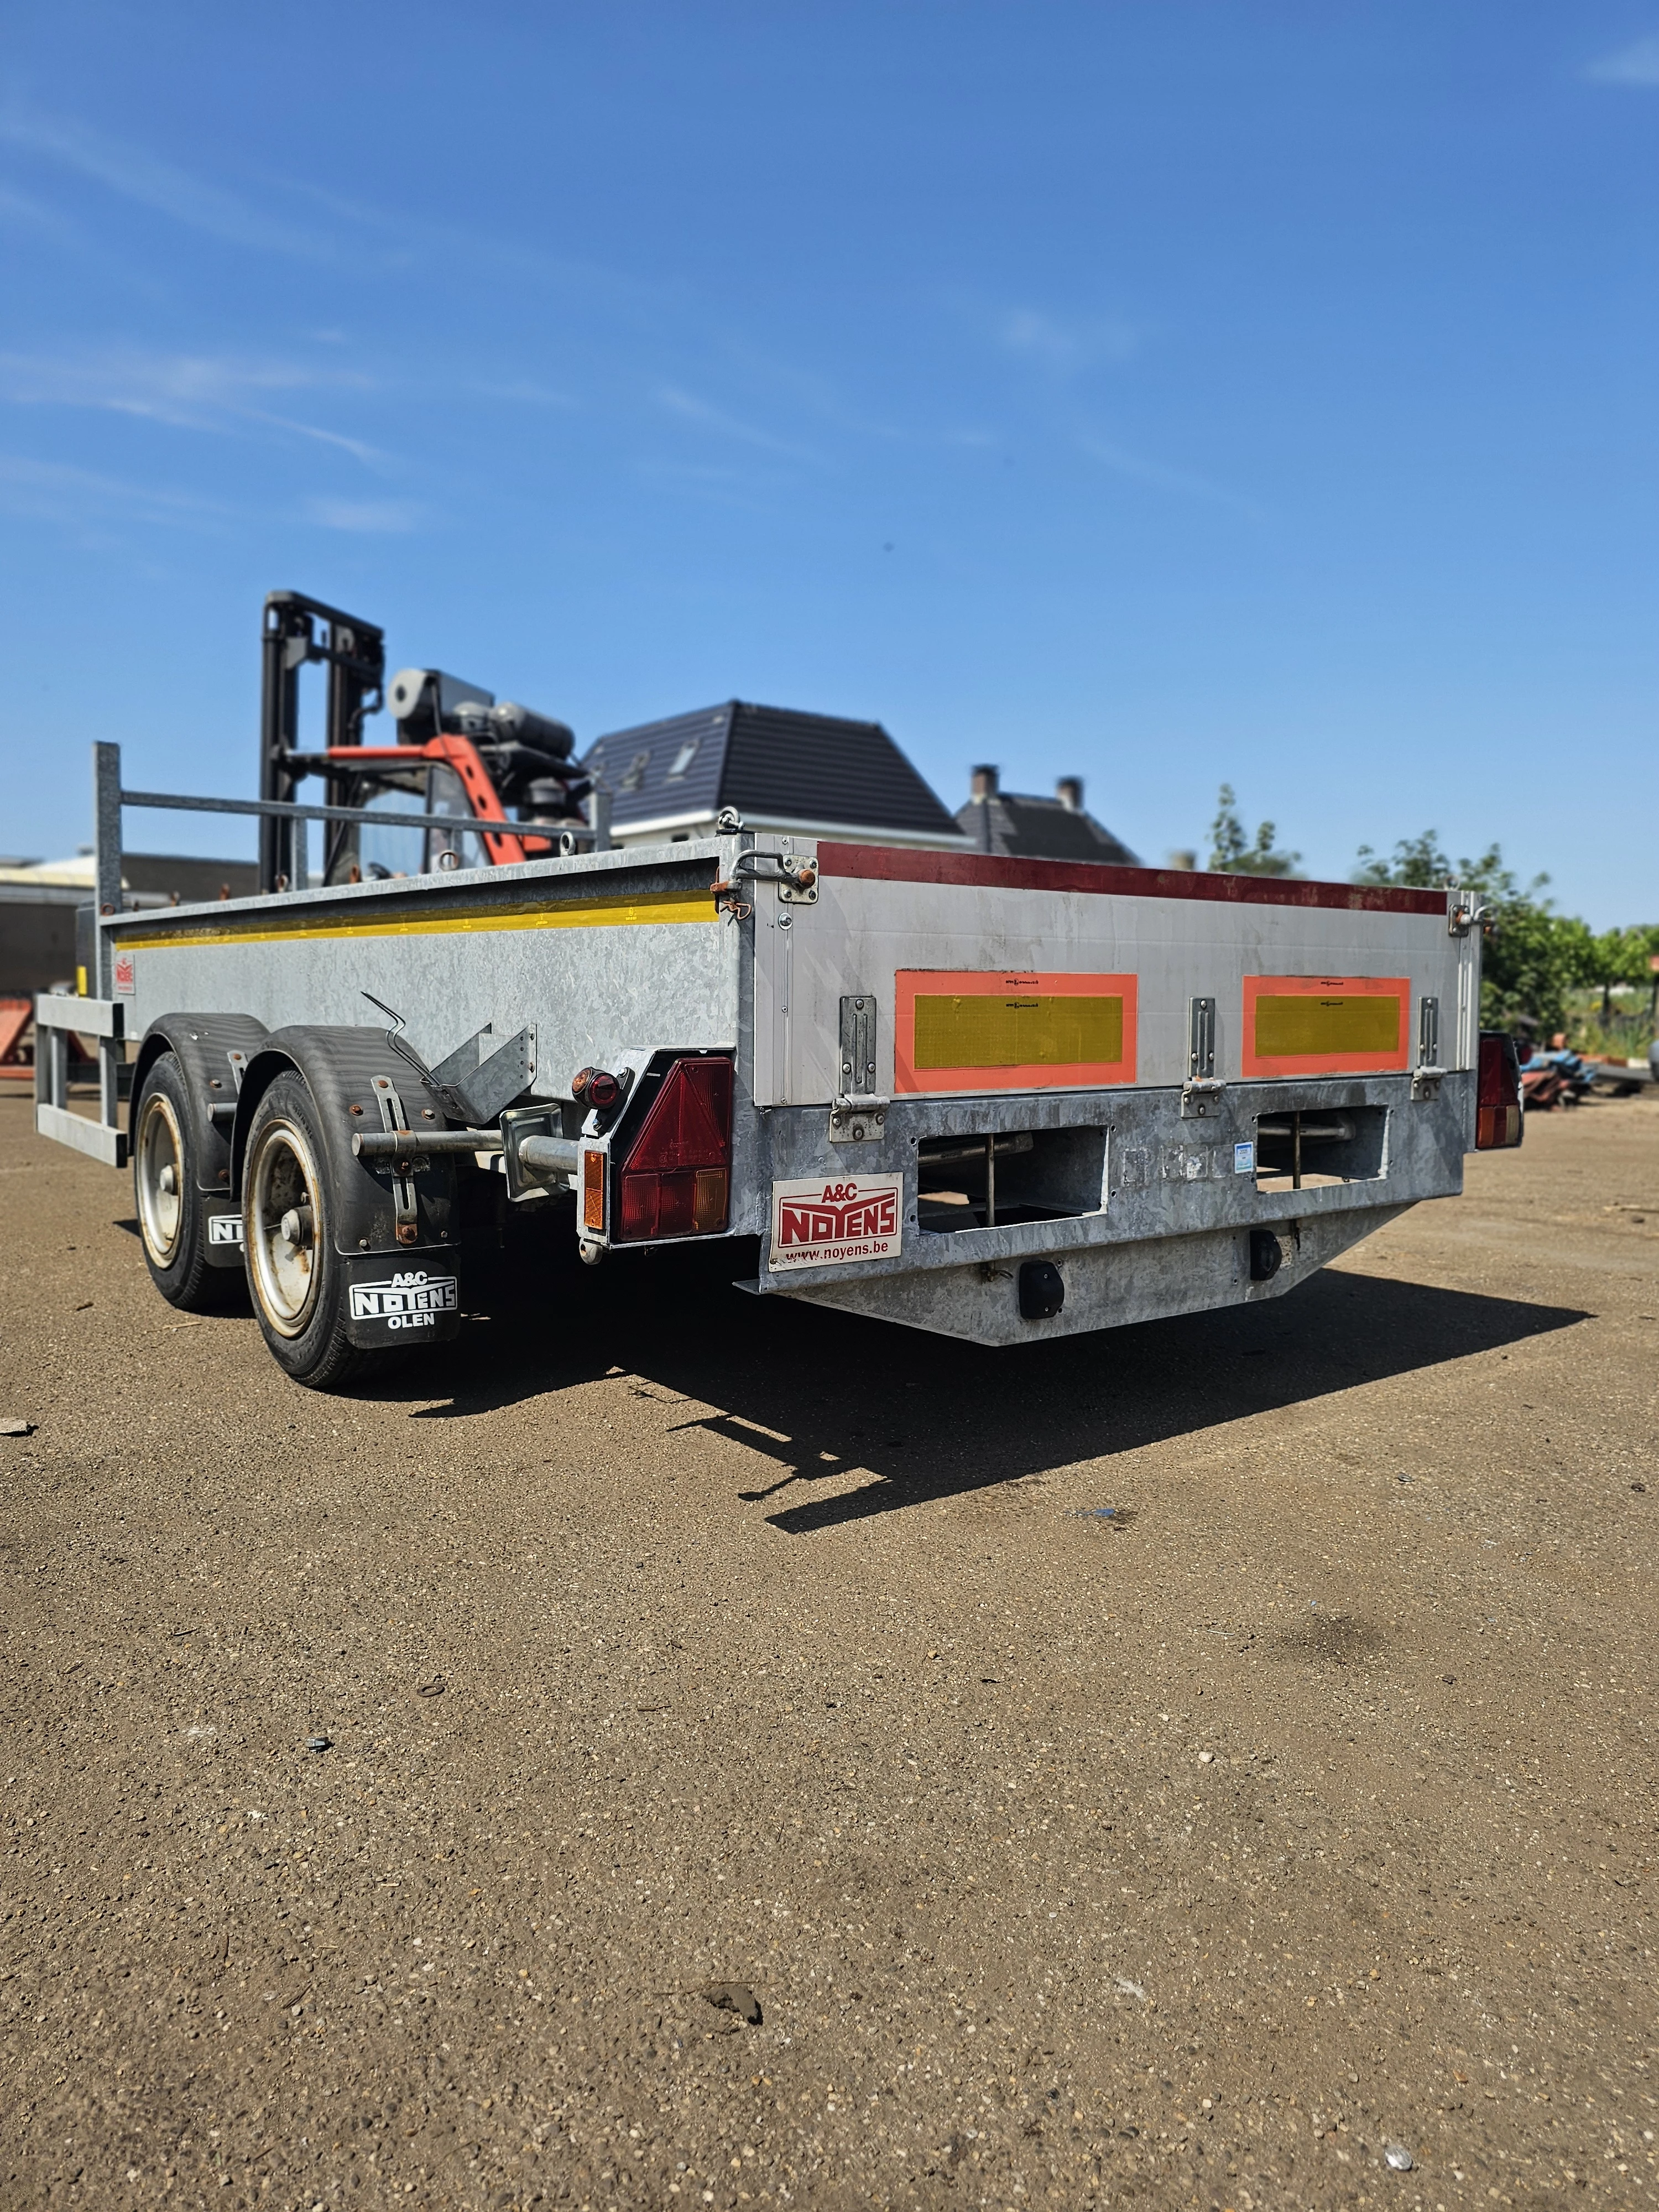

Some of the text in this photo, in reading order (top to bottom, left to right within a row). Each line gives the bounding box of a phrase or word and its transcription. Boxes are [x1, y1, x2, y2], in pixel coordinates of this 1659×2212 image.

[822, 1183, 857, 1203] A&C
[781, 1192, 895, 1244] NOYENS
[786, 1240, 888, 1263] www.noyens.be
[391, 1271, 427, 1287] A&C
[353, 1280, 455, 1316] NOYENS
[388, 1313, 435, 1329] OLEN
